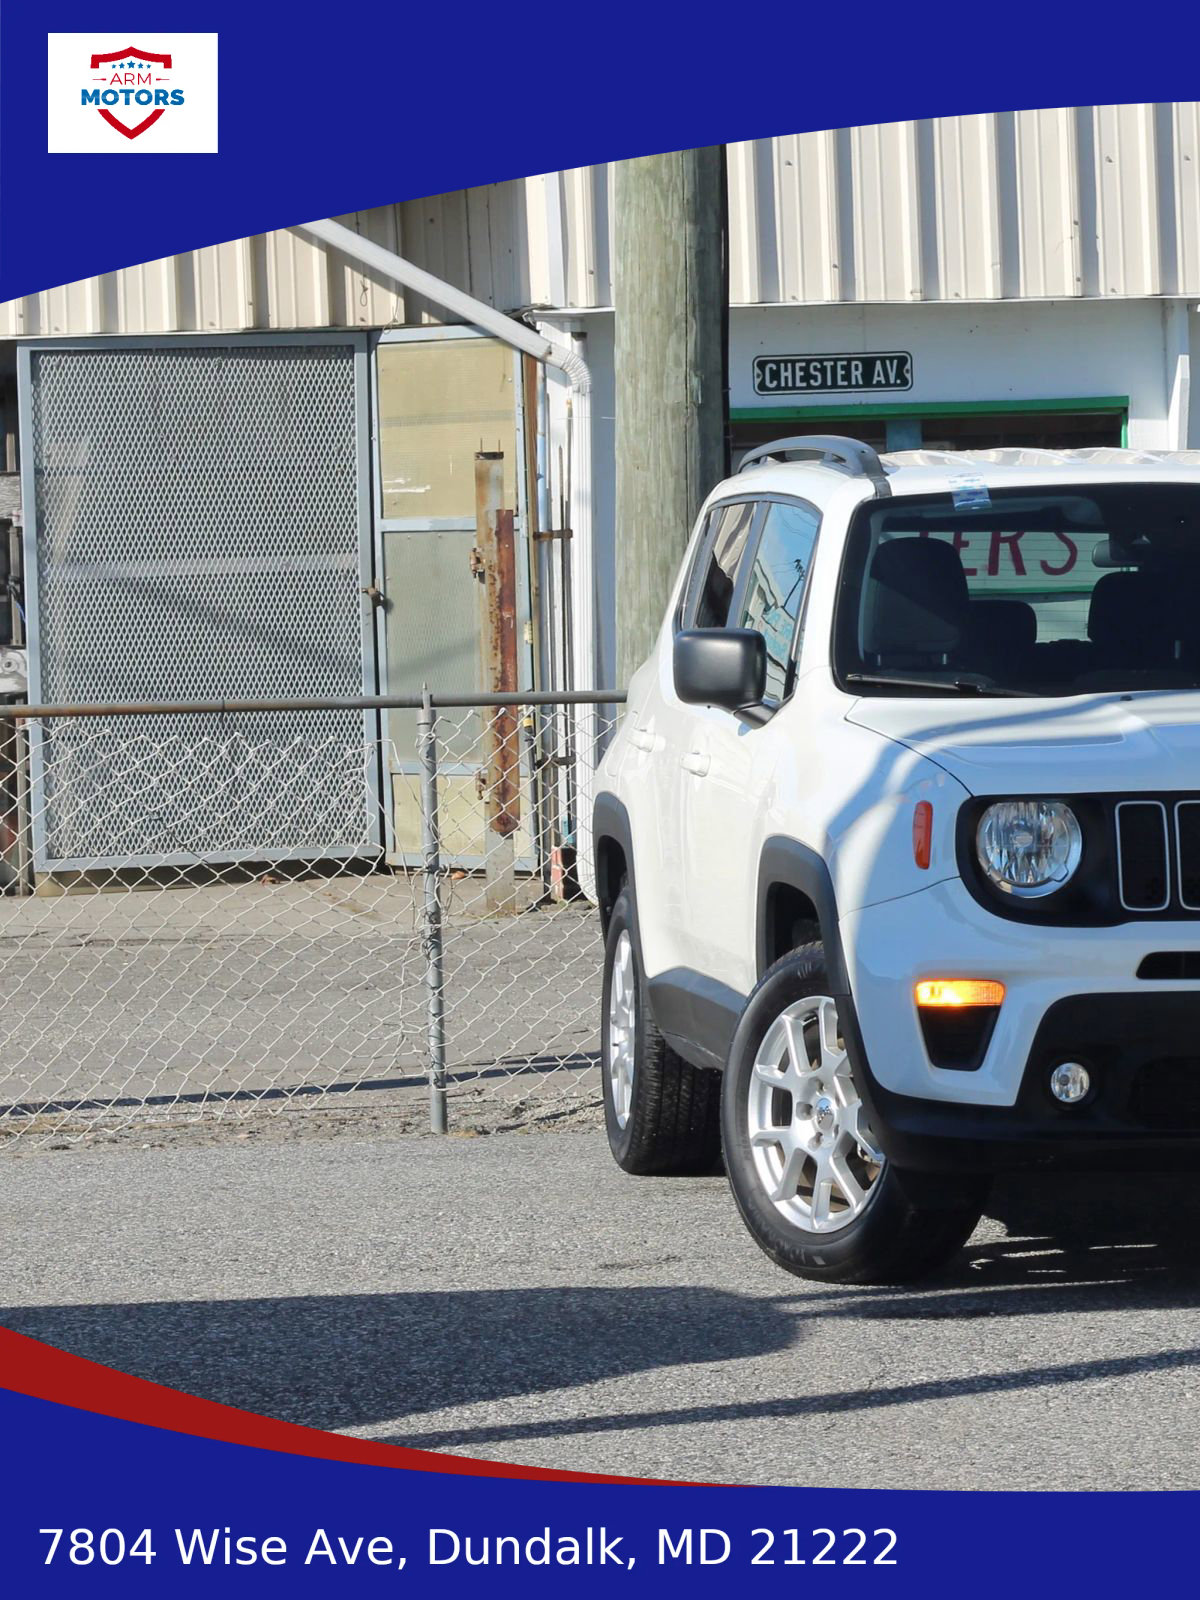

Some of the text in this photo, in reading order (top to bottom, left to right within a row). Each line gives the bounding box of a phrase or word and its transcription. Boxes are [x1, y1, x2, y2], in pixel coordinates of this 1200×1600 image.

[764, 359, 902, 389] CHESTER AV.
[919, 531, 1078, 577] ERS
